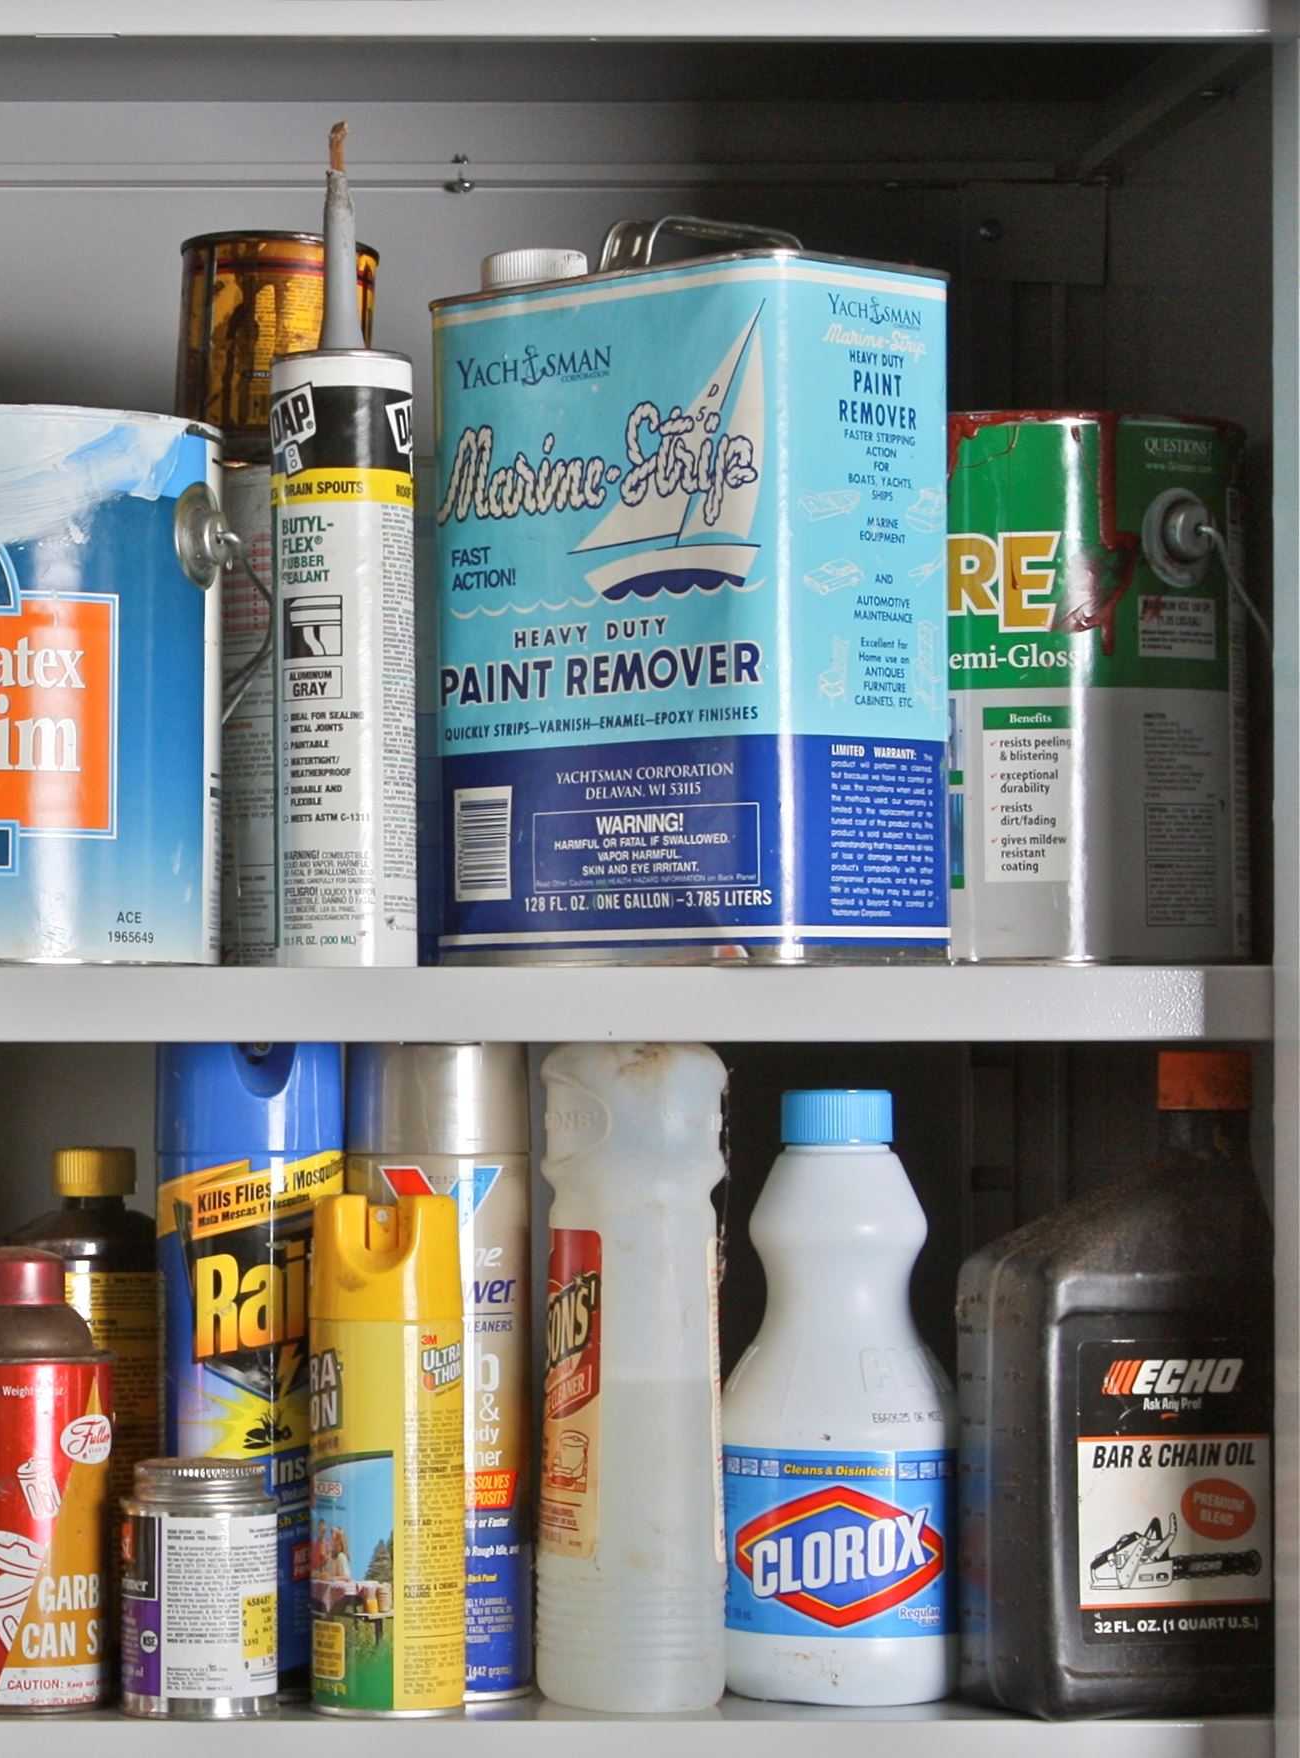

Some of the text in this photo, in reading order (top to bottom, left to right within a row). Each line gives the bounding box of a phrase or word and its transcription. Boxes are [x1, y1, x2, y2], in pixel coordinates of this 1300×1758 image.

[849, 349, 904, 368] HEAVY DUTY
[853, 369, 902, 397] PAINT
[839, 399, 917, 430] REMOVER
[844, 428, 915, 446] FASTER STRIPPING
[865, 446, 896, 458] ACTION
[873, 461, 889, 471] FOR
[316, 480, 363, 493] SPOUTS
[848, 473, 913, 489] BOATS, YACHTS,
[871, 489, 893, 501] SHIPS
[866, 516, 898, 529] MARINE
[859, 530, 905, 543] EQUIPMENT
[451, 547, 490, 567] FAST
[451, 568, 516, 591] ACTION!
[874, 573, 893, 584] AND
[947, 530, 1062, 633] RE
[856, 595, 910, 608] AUTOMOTIVE
[853, 610, 912, 623] MAINTENANCE
[512, 617, 667, 650] HEAVY DUTY
[860, 636, 895, 649] Excellent
[858, 652, 883, 663] Home
[289, 670, 332, 681] ALUMINUM
[441, 641, 762, 707] PAINT REMOVER
[864, 666, 905, 678] ANTIQUES
[292, 682, 327, 697] GRAY
[863, 681, 906, 693] FURNITURE
[854, 695, 896, 708] CABINETS,
[311, 710, 326, 720] FOR
[1009, 712, 1051, 723] Benefits
[314, 723, 343, 733] JOINTS
[444, 705, 758, 741] QUICKLY FINISHES
[290, 740, 329, 750] PAINTABLE
[999, 736, 1071, 749] resists peeling
[831, 744, 916, 760] LIMITED WARRANTY:
[999, 750, 1058, 763] & blistering
[555, 762, 734, 785] YACHTSMAN CORPORATION
[999, 769, 1058, 785] exceptional
[324, 784, 342, 794] AND
[648, 781, 701, 796] WI 53115
[1000, 782, 1050, 794] durability
[1000, 801, 1032, 812] resists
[595, 812, 684, 834] WARNING!
[1000, 815, 1056, 828] dirt/fading
[553, 832, 730, 850] HARMFUL OR FATAL IF SWALLOWED.
[1000, 833, 1067, 847] gives mildew
[597, 848, 681, 860] VAPOR HARMFUL.
[1000, 847, 1045, 858] resistant
[582, 860, 699, 874] SKIN AND EYE IRRITANT.
[1000, 861, 1038, 872] coating
[524, 888, 772, 912] 128 FL. OZ. LITERS
[116, 911, 141, 924] ACE
[107, 929, 154, 944] 1965649
[197, 1180, 272, 1213] Kills Flies
[198, 1206, 256, 1227] Mata Moscas
[421, 1334, 437, 1344] 3M
[1131, 1358, 1244, 1395] ECHO
[1142, 1397, 1180, 1413] Ask Any
[1092, 1442, 1255, 1468] BAR & CHAIN OIL
[783, 1463, 894, 1476] Cleans & Disinfects
[1192, 1492, 1244, 1510] PREMIUM
[1199, 1510, 1234, 1526] BLEND
[752, 1507, 930, 1599] CLOROX
[900, 1606, 940, 1623] Regular
[1094, 1616, 1258, 1634] 32 FL. OZ. (1 QUART U.S.)
[21, 1620, 77, 1660] CAN
[6, 1679, 64, 1690] CAUTION:
